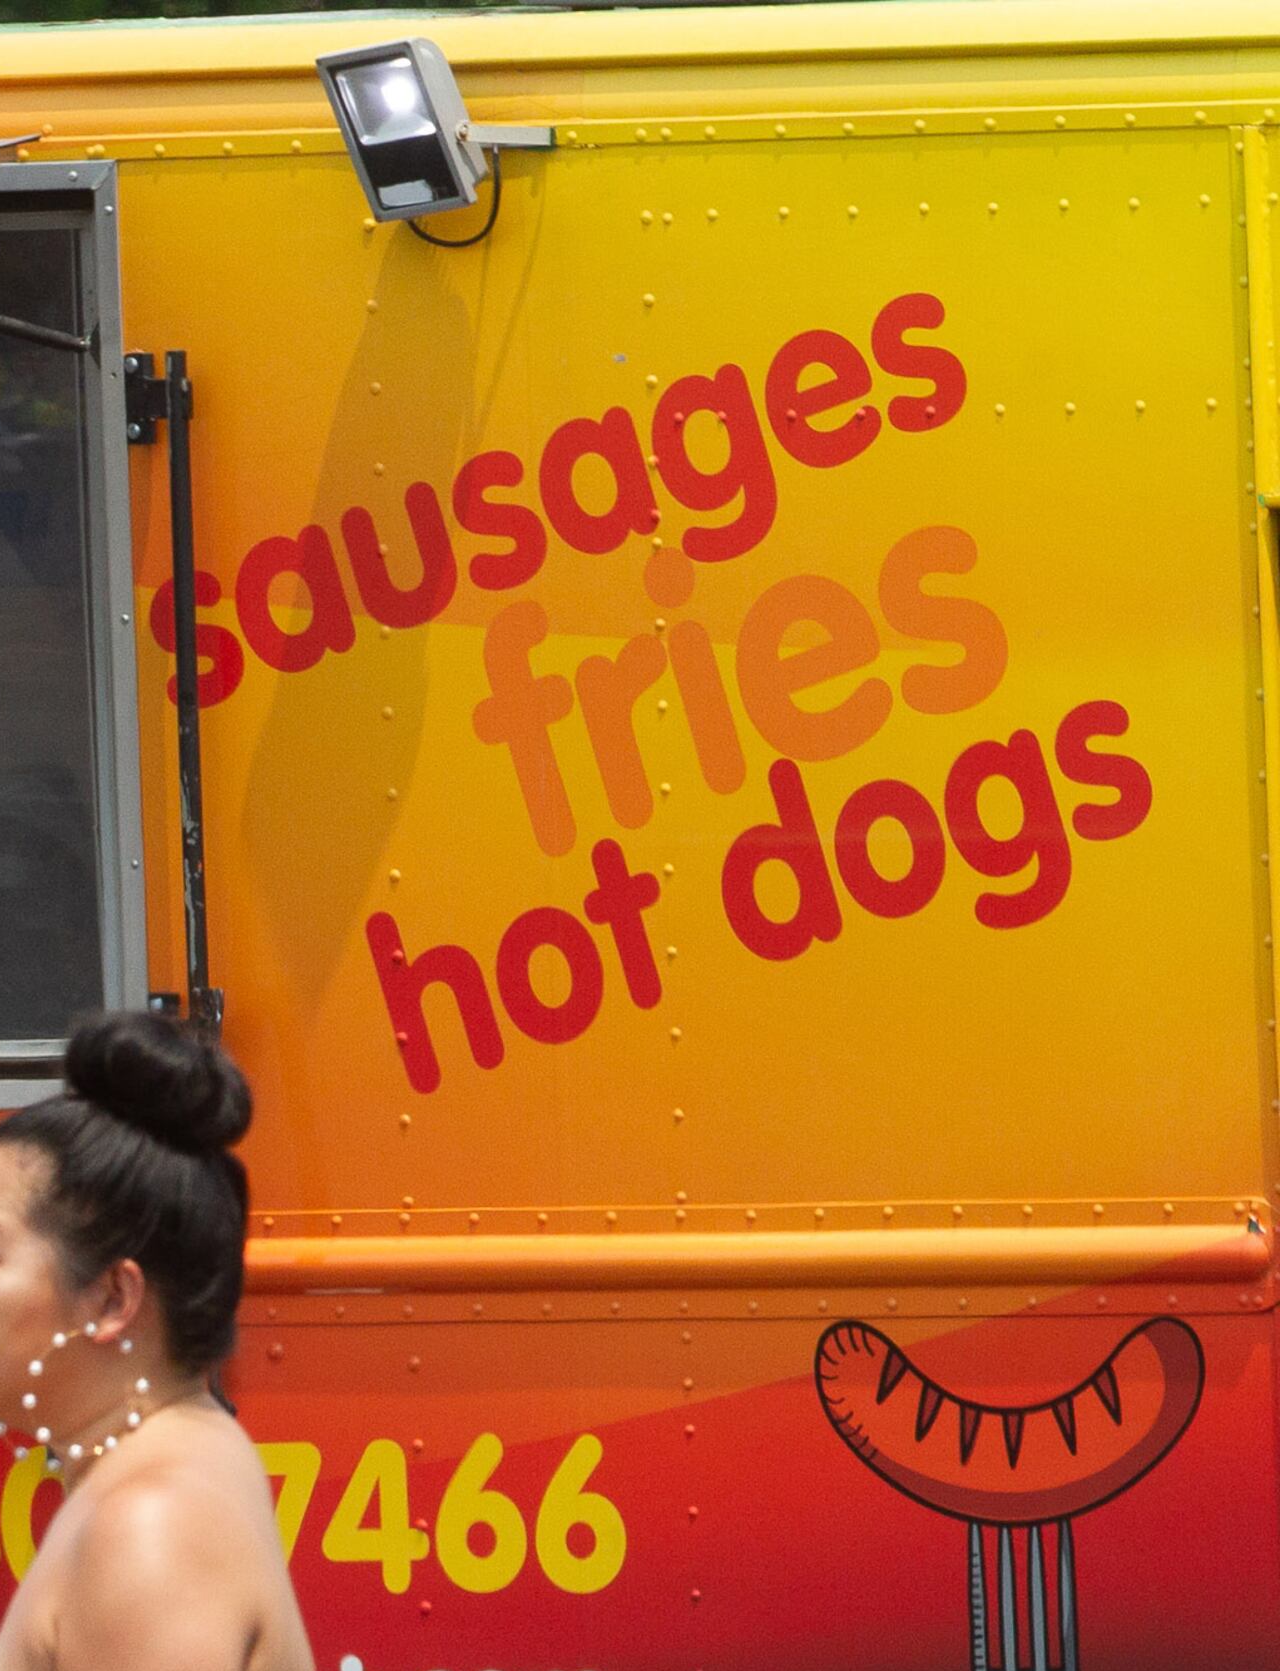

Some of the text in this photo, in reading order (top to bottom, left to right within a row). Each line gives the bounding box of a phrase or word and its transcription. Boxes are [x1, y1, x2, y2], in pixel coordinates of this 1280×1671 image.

[149, 292, 966, 708] sausages
[471, 526, 1008, 857] fries
[365, 701, 1152, 1094] hot dogs
